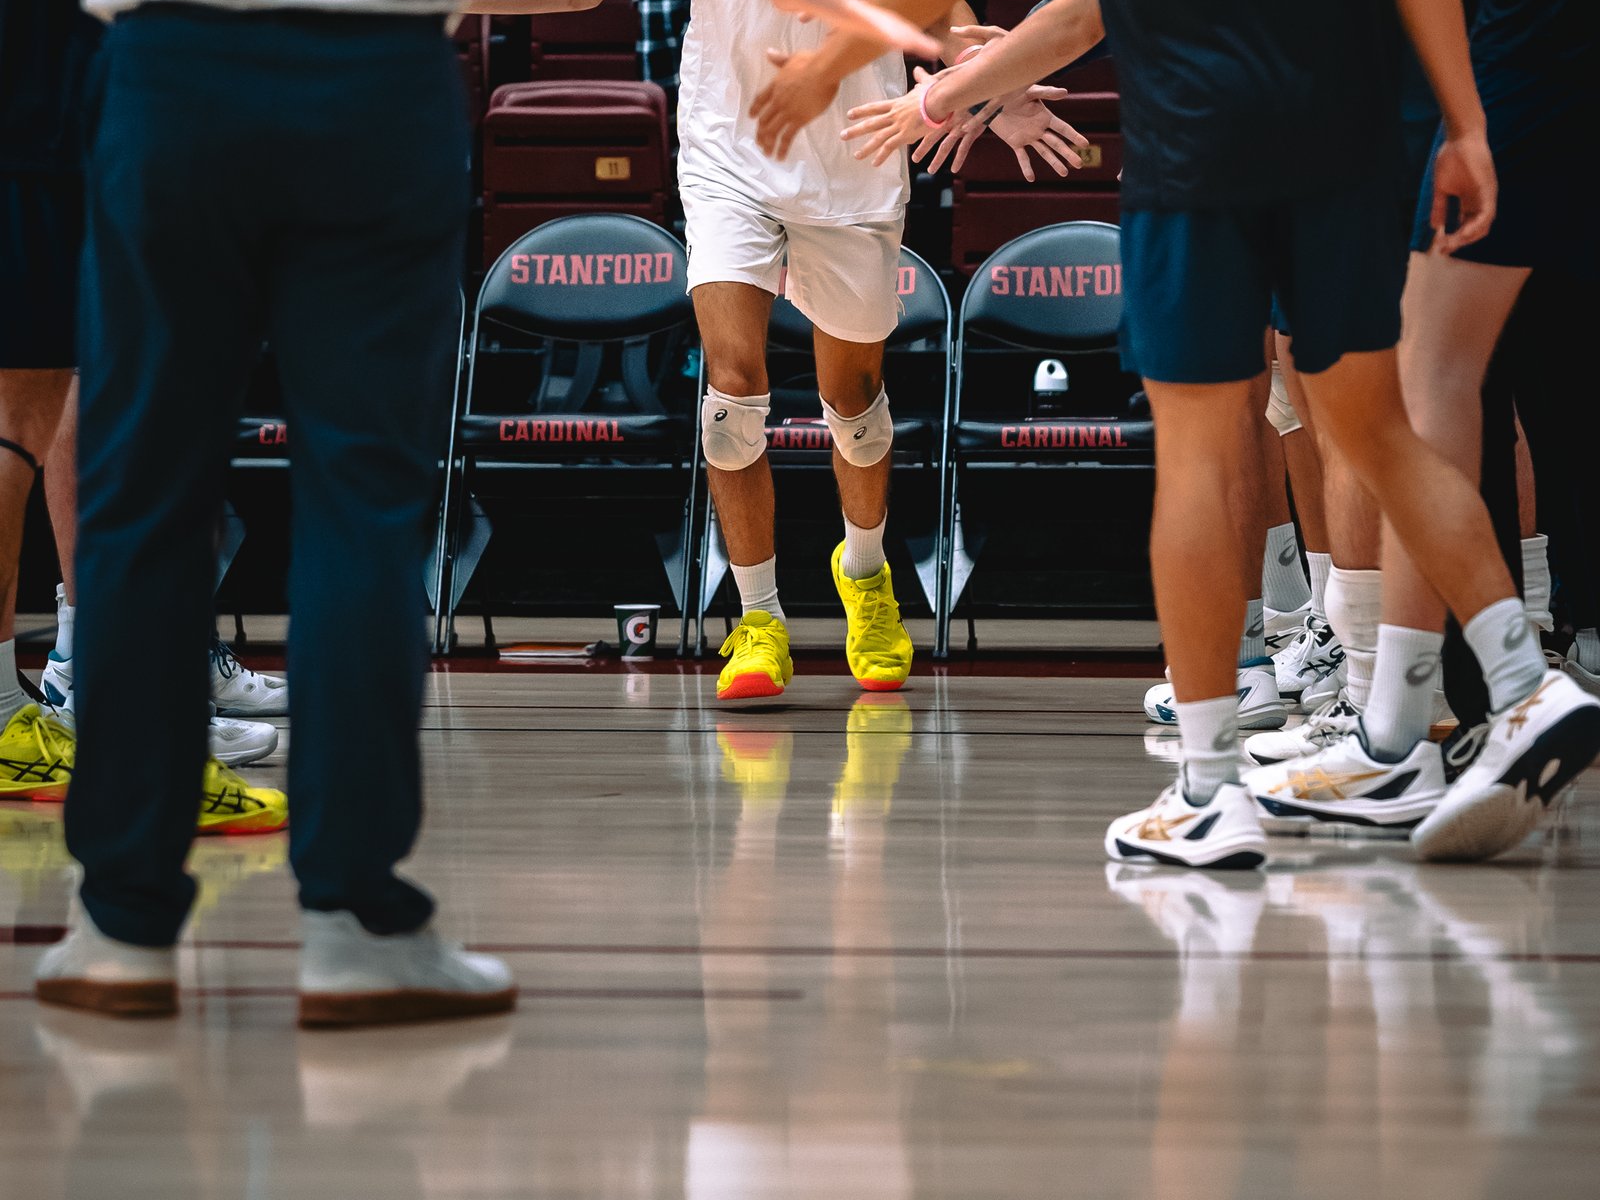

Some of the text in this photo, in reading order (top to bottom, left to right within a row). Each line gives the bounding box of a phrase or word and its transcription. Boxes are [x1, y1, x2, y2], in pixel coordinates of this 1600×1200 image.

[511, 252, 673, 285] STANFORD
[500, 419, 624, 442] CARDINAL
[1001, 426, 1128, 448] CARDINAL
[626, 615, 650, 645] G
